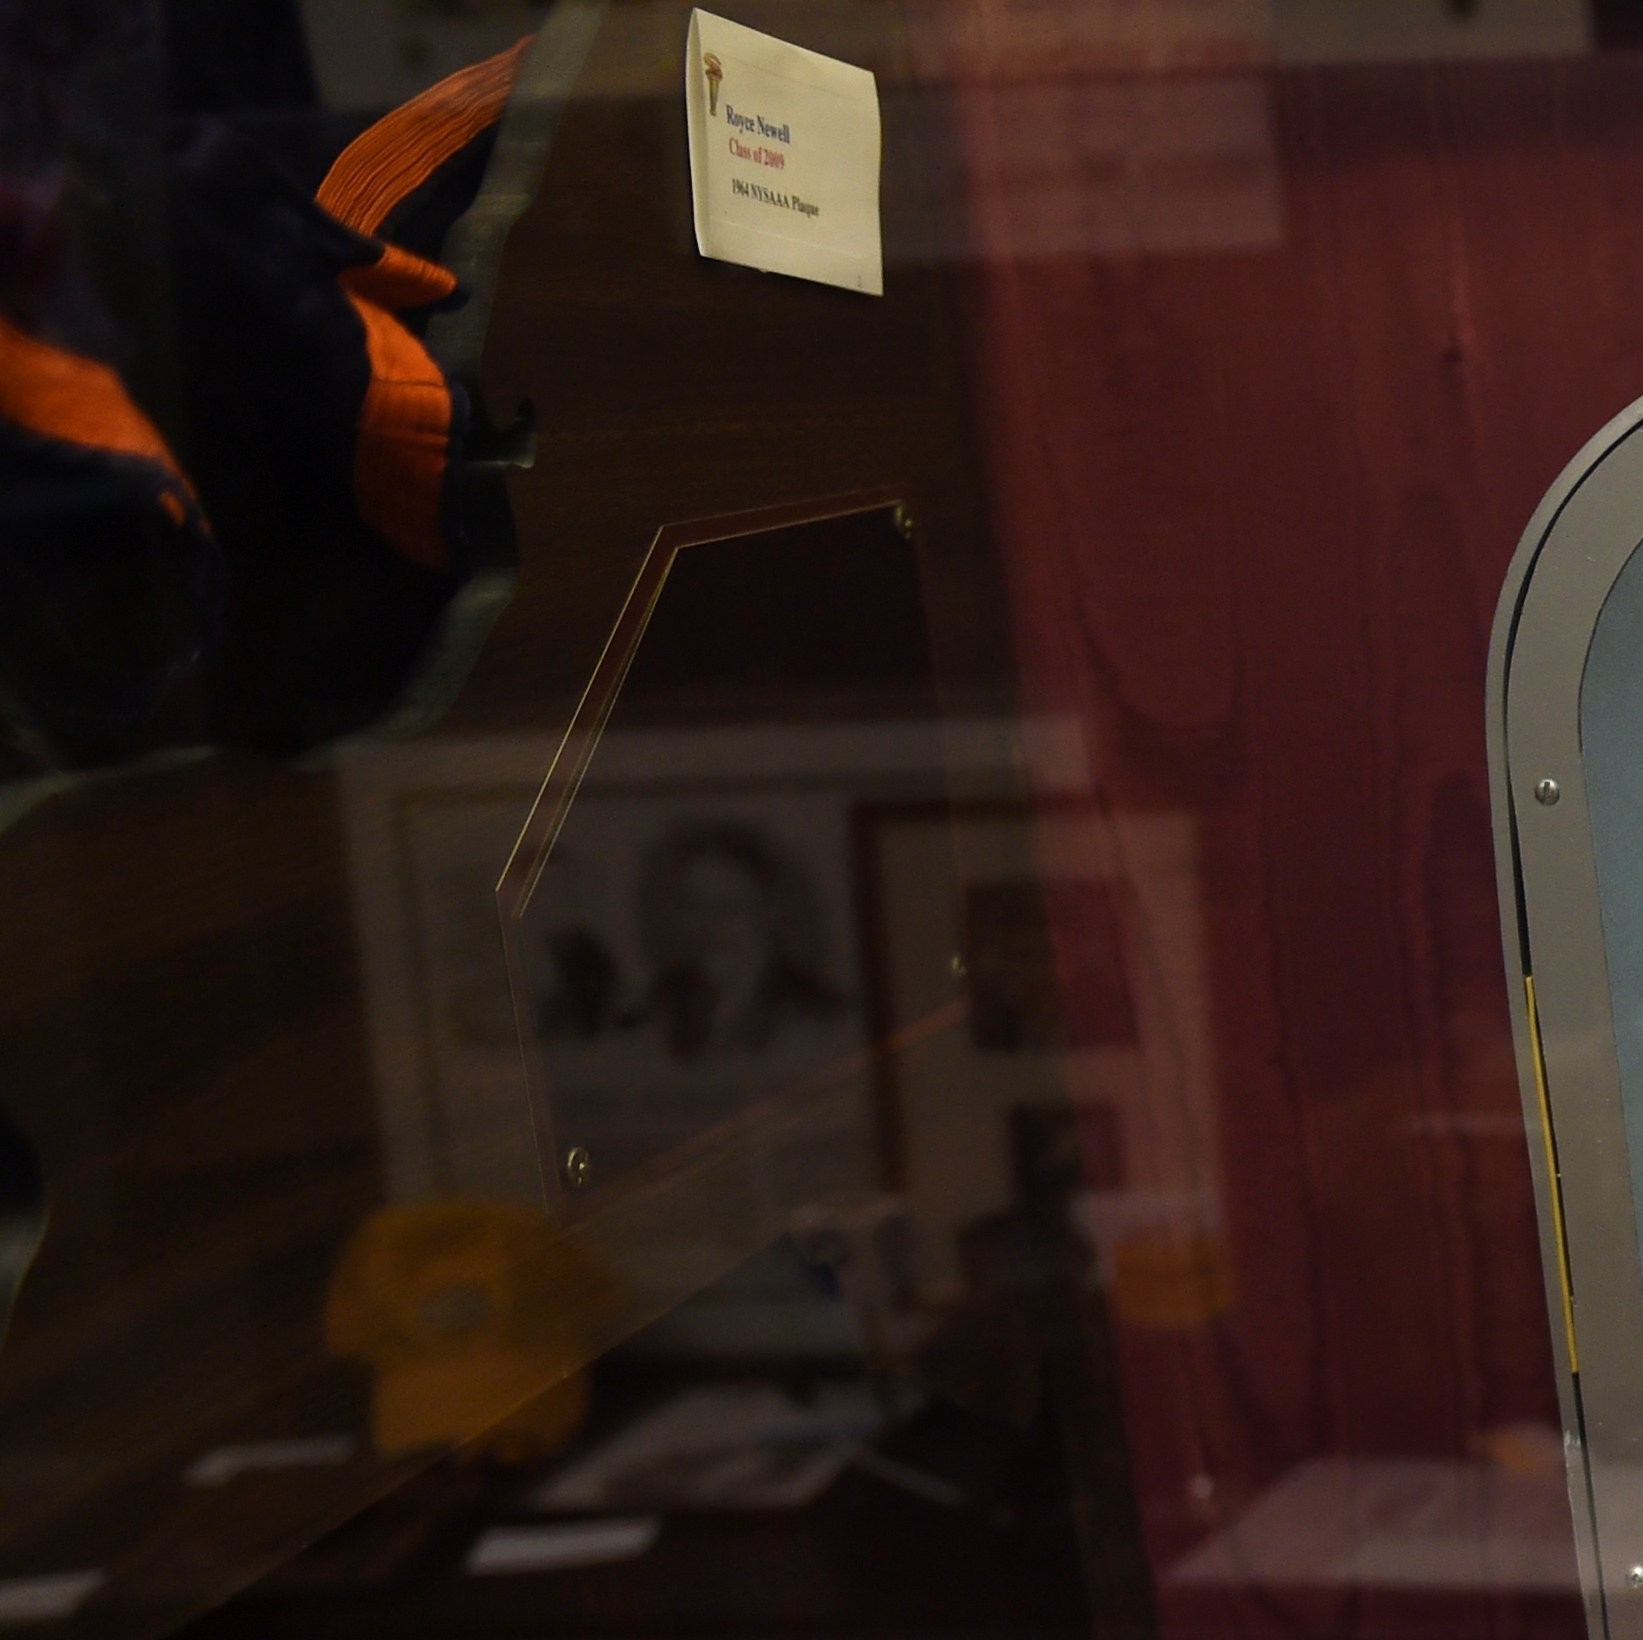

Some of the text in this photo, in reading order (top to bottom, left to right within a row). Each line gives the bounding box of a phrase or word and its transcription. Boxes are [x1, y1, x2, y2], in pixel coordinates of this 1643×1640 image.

[726, 103, 790, 144] Royce Newell
[729, 137, 751, 160] Class
[753, 146, 762, 164] of
[792, 195, 819, 219] Plaque
